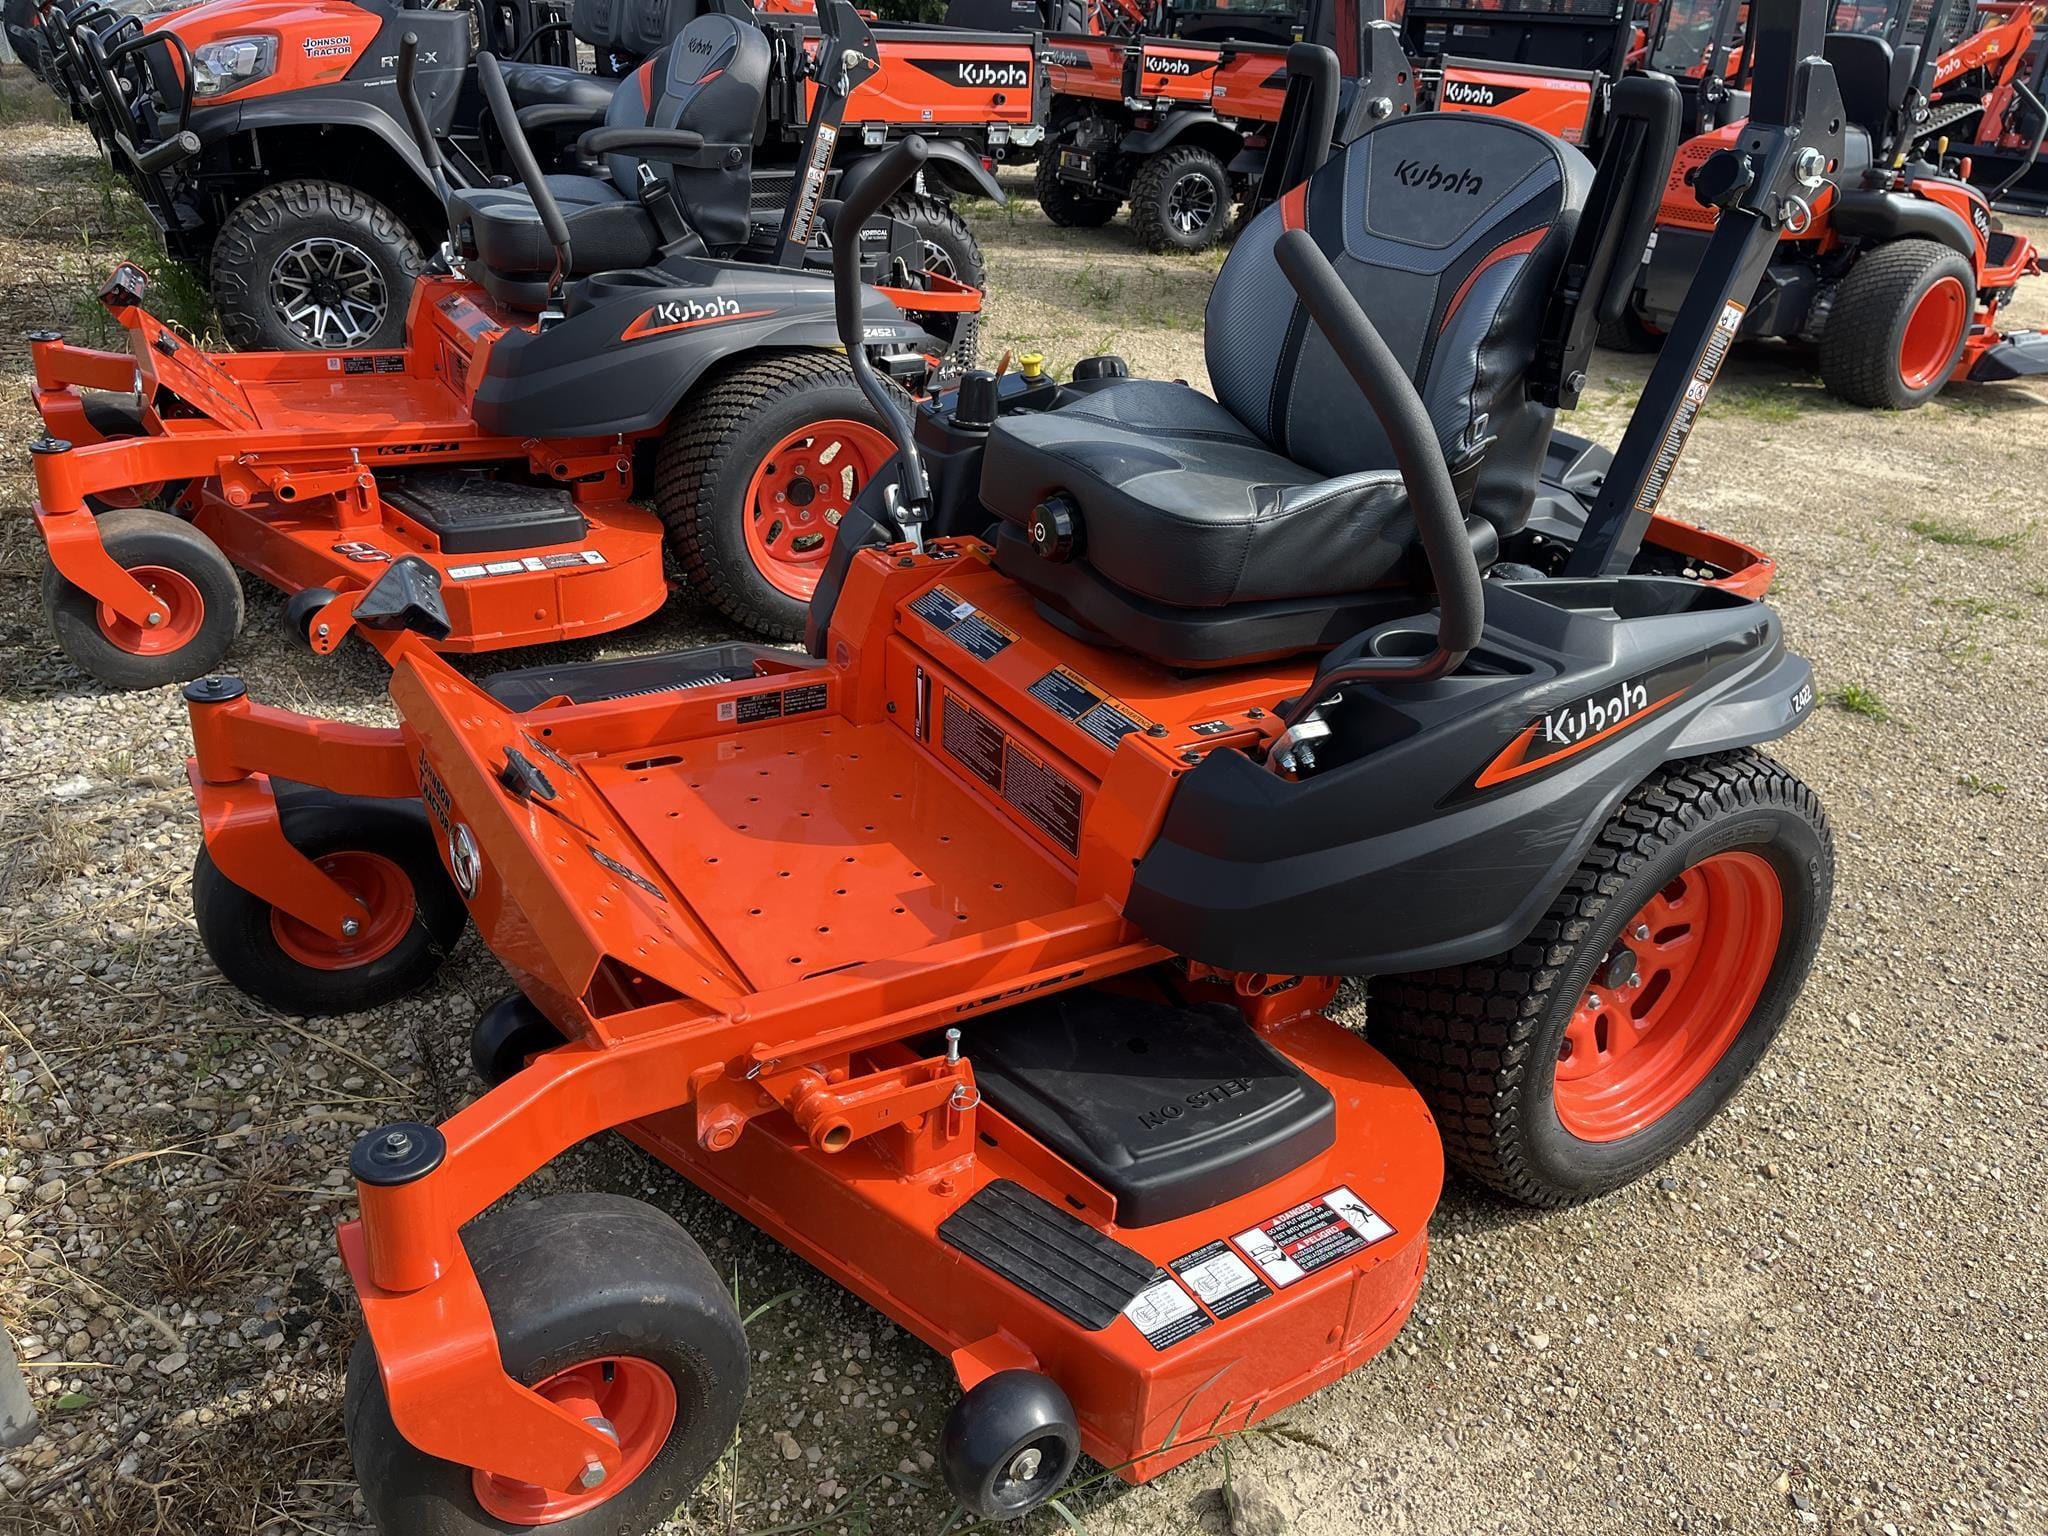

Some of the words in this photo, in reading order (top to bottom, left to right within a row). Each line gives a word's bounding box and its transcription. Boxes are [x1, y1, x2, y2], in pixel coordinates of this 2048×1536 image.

[303, 36, 349, 48] JOHNSON
[306, 46, 351, 58] TRACTOR
[958, 63, 1027, 86] Kubota
[1146, 56, 1190, 74] Kubota
[1445, 82, 1494, 105] Kubota
[1393, 159, 1485, 196] Kubota
[657, 296, 741, 323] Kubota
[1792, 684, 1813, 713] Z422
[1545, 682, 1648, 745] Kubota
[418, 748, 452, 811] JOHNSON
[419, 767, 451, 835] TRACTOR
[1137, 1102, 1185, 1131] NO
[1185, 1077, 1257, 1112] STEP
[1265, 1227, 1277, 1236] DO
[1273, 1222, 1289, 1232] NOT
[1284, 1217, 1299, 1227] PUT
[1312, 1205, 1325, 1214] OR
[1276, 1201, 1314, 1222] DANGER
[1271, 1230, 1288, 1241] FEET
[1301, 1224, 1341, 1246] PELIGRO
